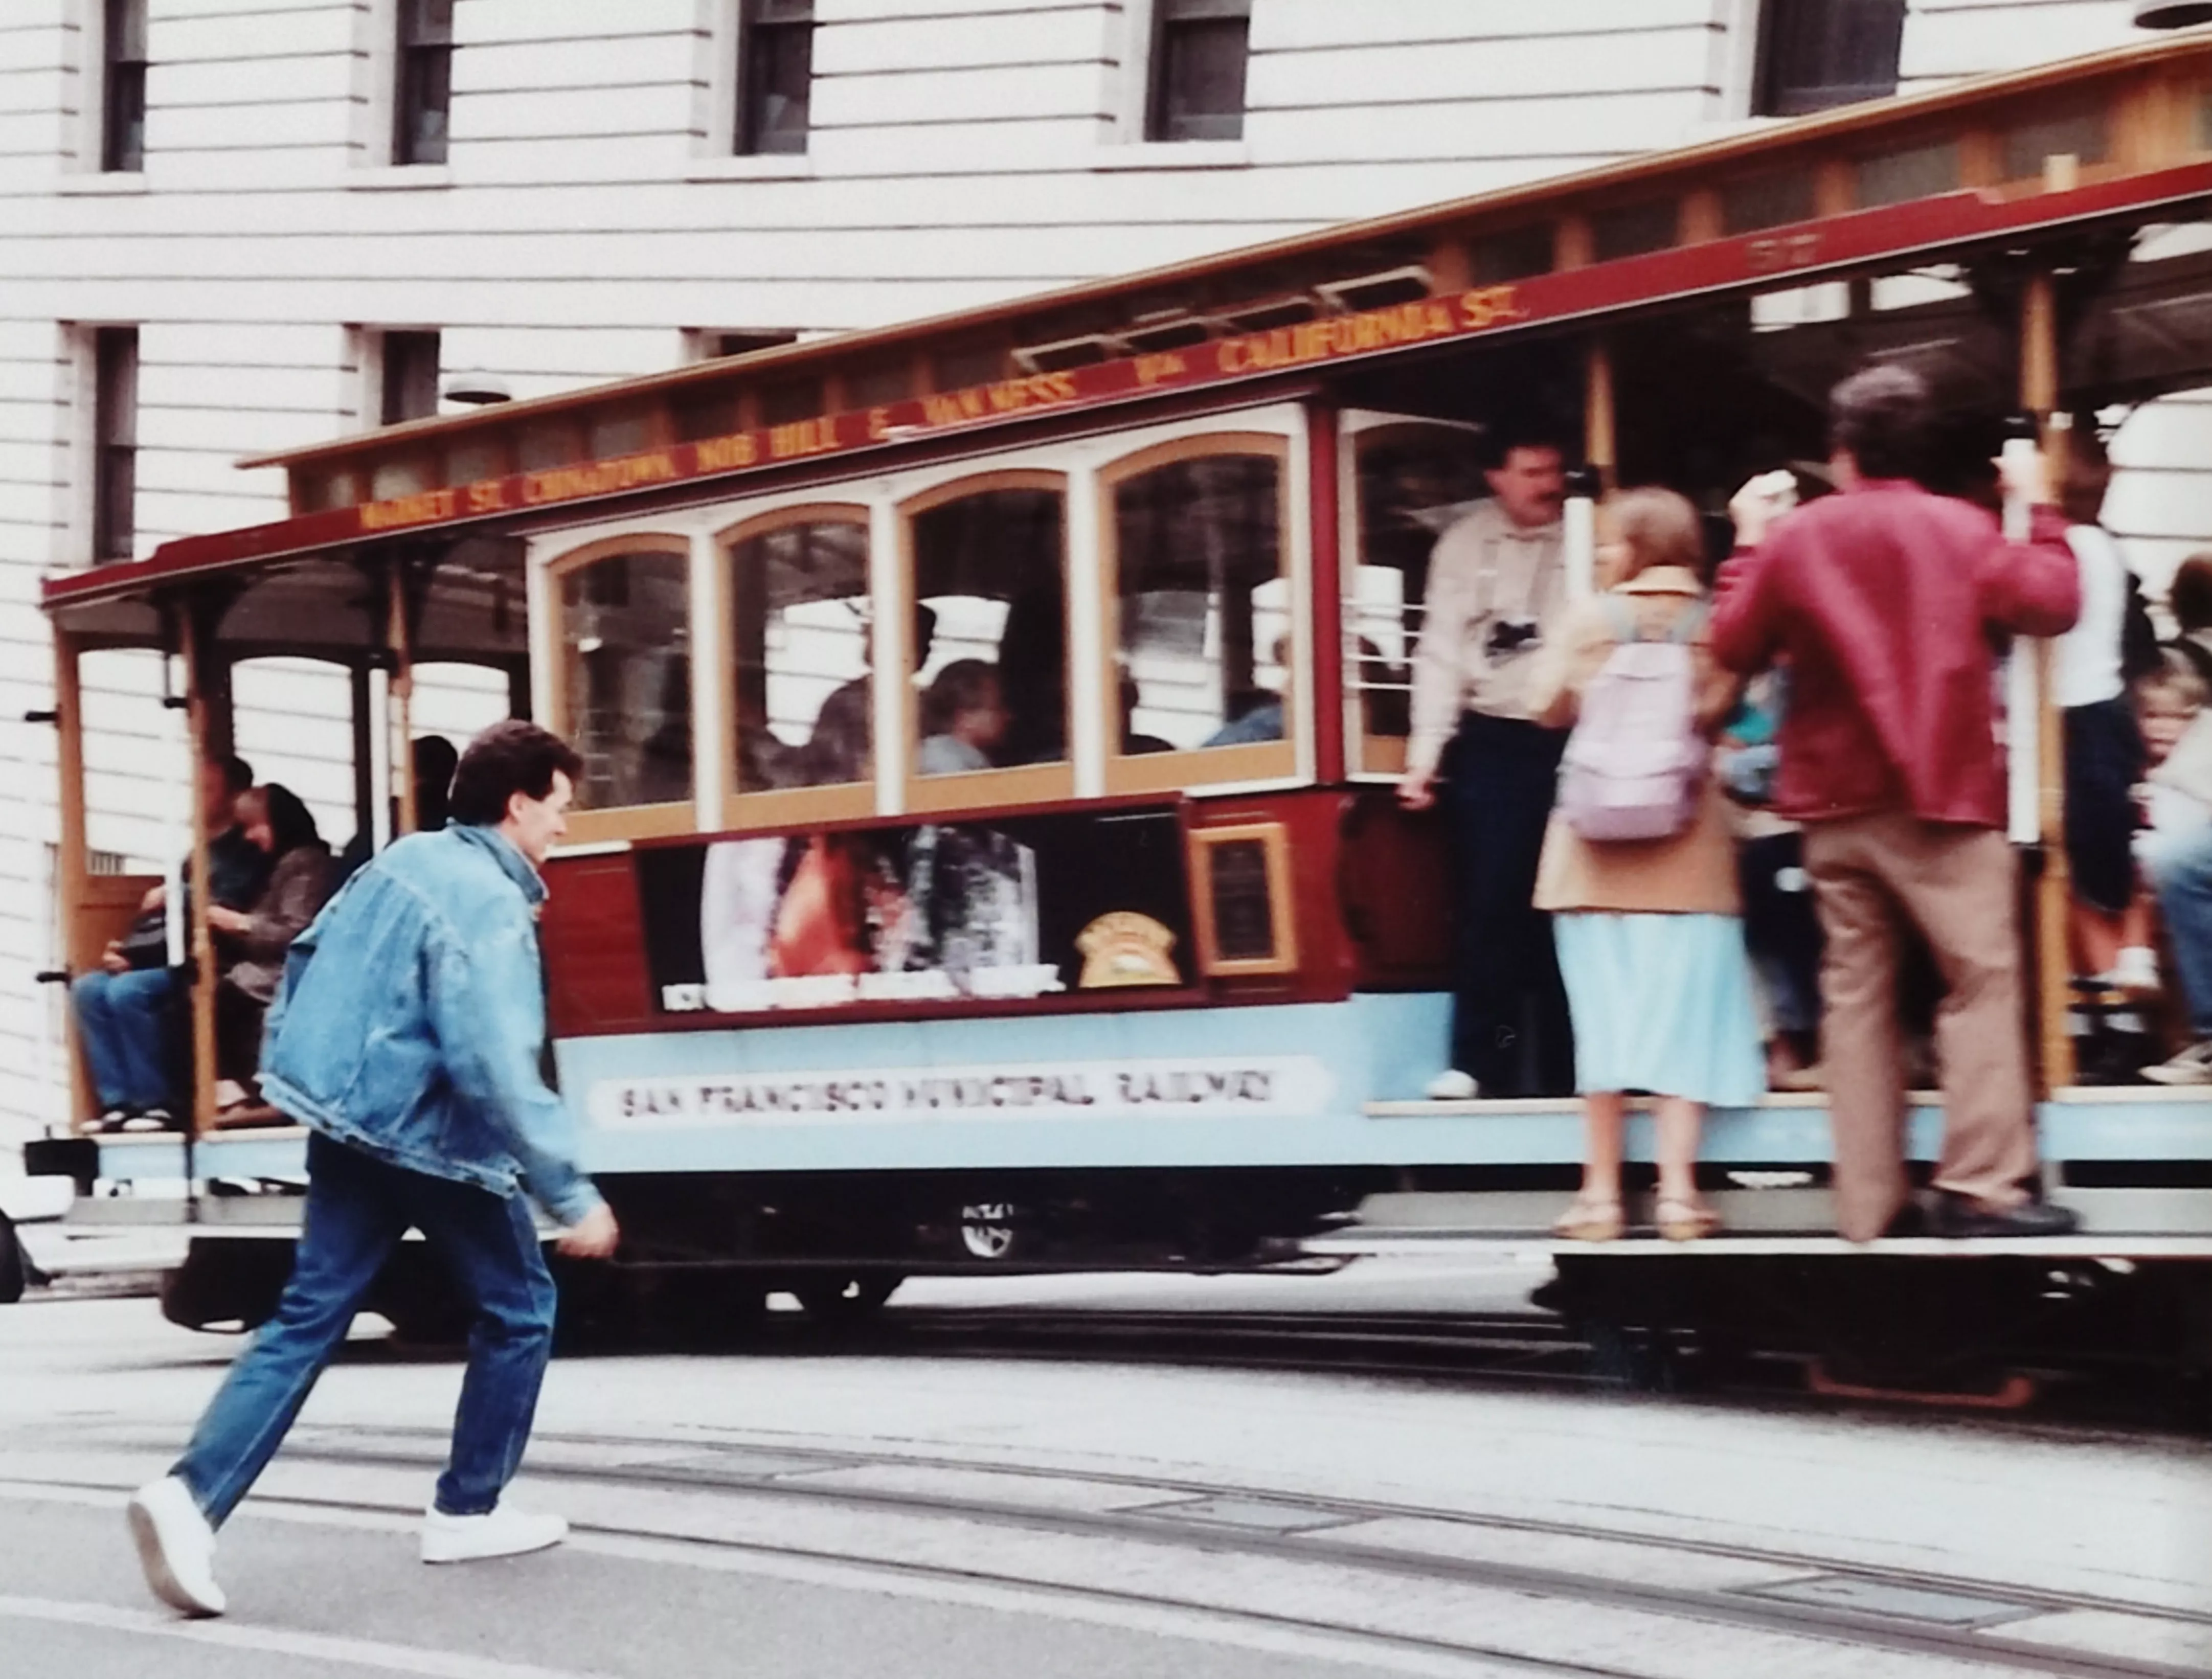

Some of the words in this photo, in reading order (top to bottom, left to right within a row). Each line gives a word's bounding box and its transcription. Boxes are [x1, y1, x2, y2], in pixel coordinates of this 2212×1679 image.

[771, 416, 843, 457] HILL
[1218, 303, 1453, 373] CALIFORNIA
[619, 1088, 684, 1116] SAN
[698, 1080, 889, 1114] FRANCISCO
[901, 1075, 1095, 1109] MUNICIPAL
[1116, 1070, 1273, 1103] RAILWAY
